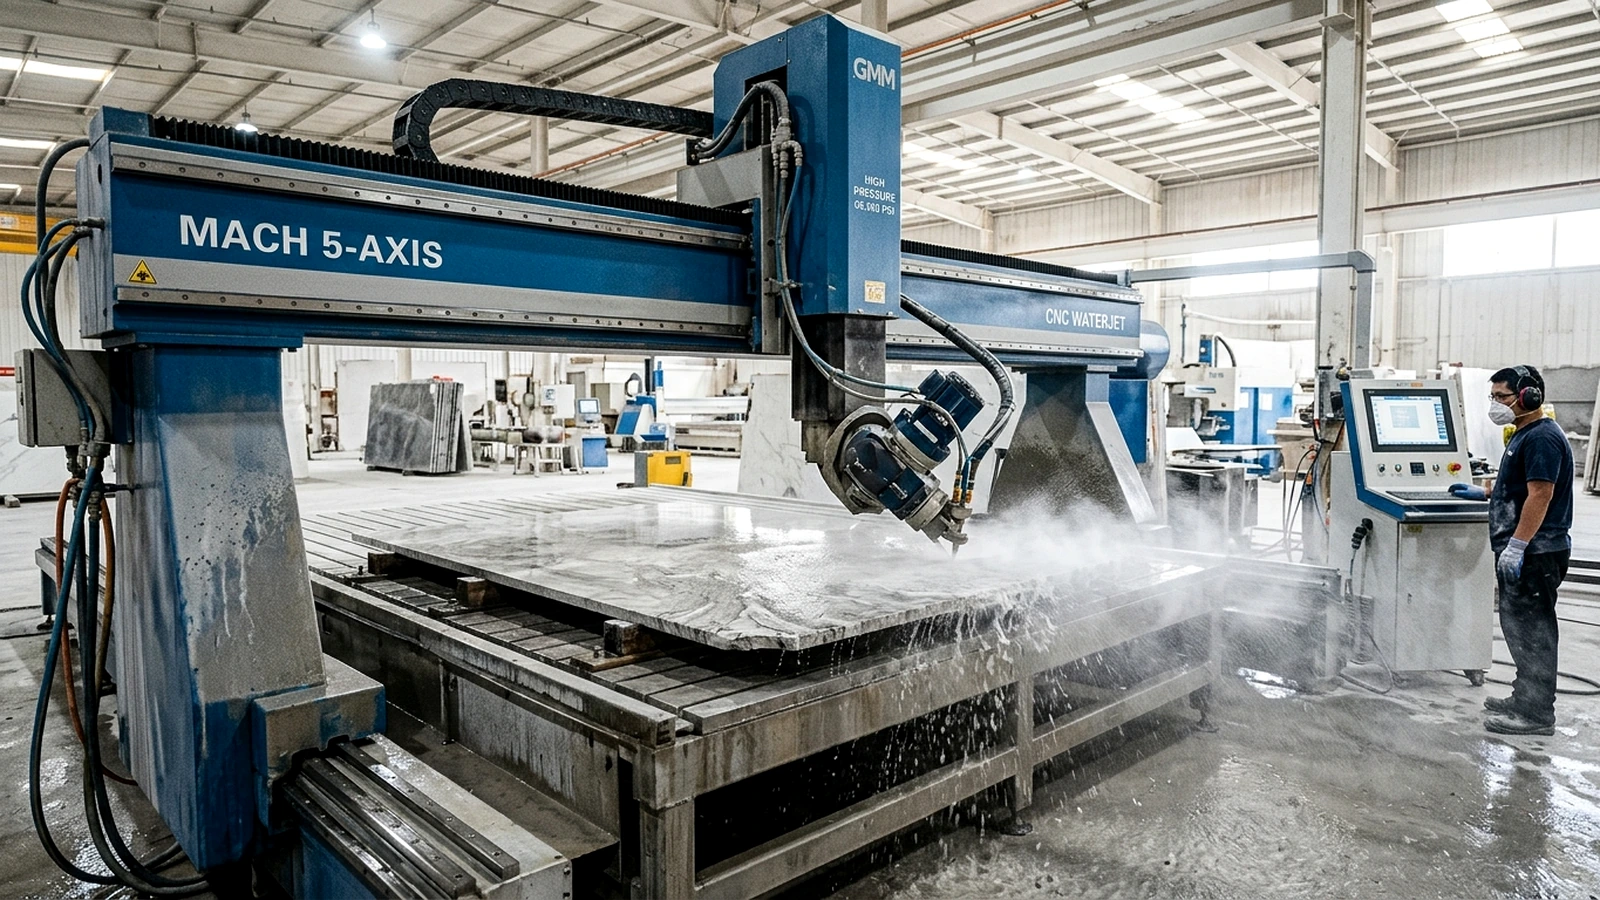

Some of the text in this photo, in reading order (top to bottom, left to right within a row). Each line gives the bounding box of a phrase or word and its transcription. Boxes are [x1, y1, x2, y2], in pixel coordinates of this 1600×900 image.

[853, 57, 895, 90] GMM
[864, 174, 885, 187] HIGH
[853, 185, 896, 203] PRESSURE
[179, 214, 443, 269] MACH 5-AXIS
[1045, 307, 1126, 331] CNC WATERJET
